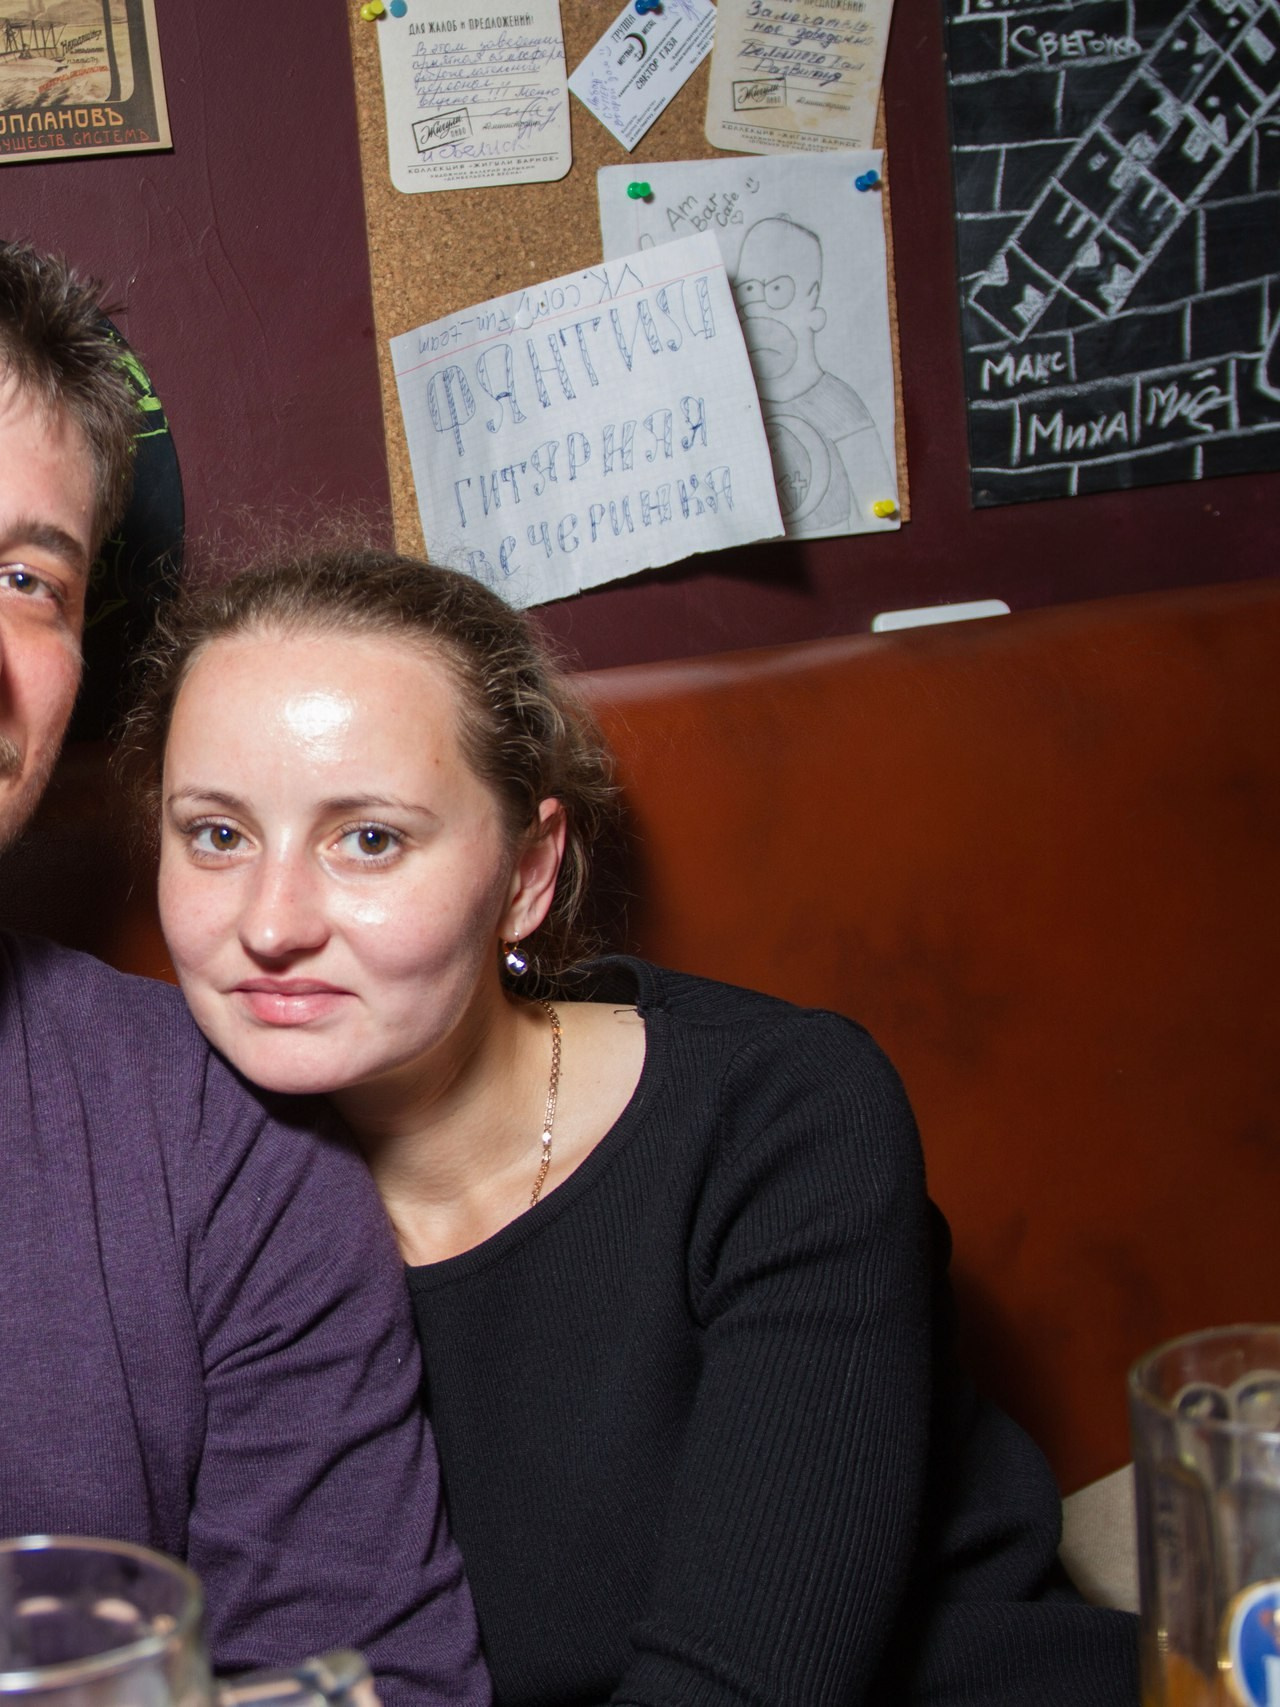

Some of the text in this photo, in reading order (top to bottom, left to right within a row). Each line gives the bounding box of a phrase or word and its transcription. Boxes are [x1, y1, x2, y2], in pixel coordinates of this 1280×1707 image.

[409, 22, 426, 36] ДЛЯ
[428, 19, 458, 33] ЖАЛОБ
[468, 12, 534, 30] ПРЕДЛОЖЕНИЙ!
[611, 14, 637, 43] ГРУППА
[659, 37, 679, 59] ГАЗА
[738, 83, 779, 104] Жигули
[73, 128, 150, 149] СИСТЕМЪ
[420, 115, 462, 145] Жигули
[408, 164, 465, 174] КОЛЛЕКЦИЯ
[666, 195, 698, 232] Am
[690, 192, 718, 232] Bar
[715, 192, 739, 227] Cafe
